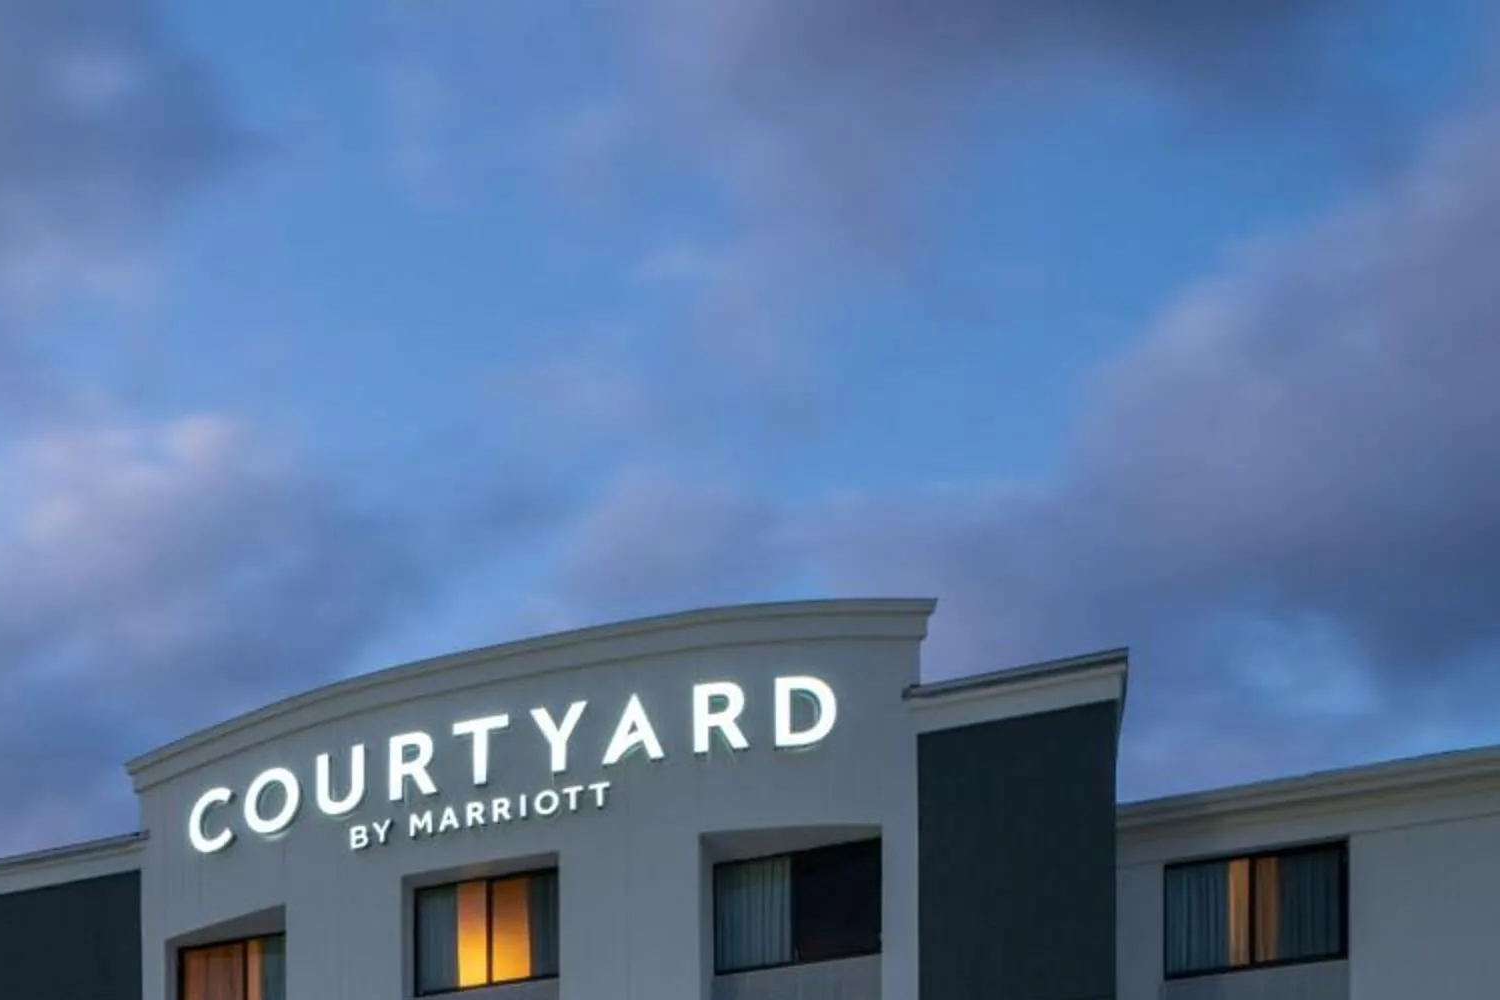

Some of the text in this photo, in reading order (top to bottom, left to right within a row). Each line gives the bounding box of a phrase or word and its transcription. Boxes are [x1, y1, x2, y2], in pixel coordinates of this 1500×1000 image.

[187, 674, 838, 854] COURTYARD
[349, 781, 611, 850] BY MARRIOTT
